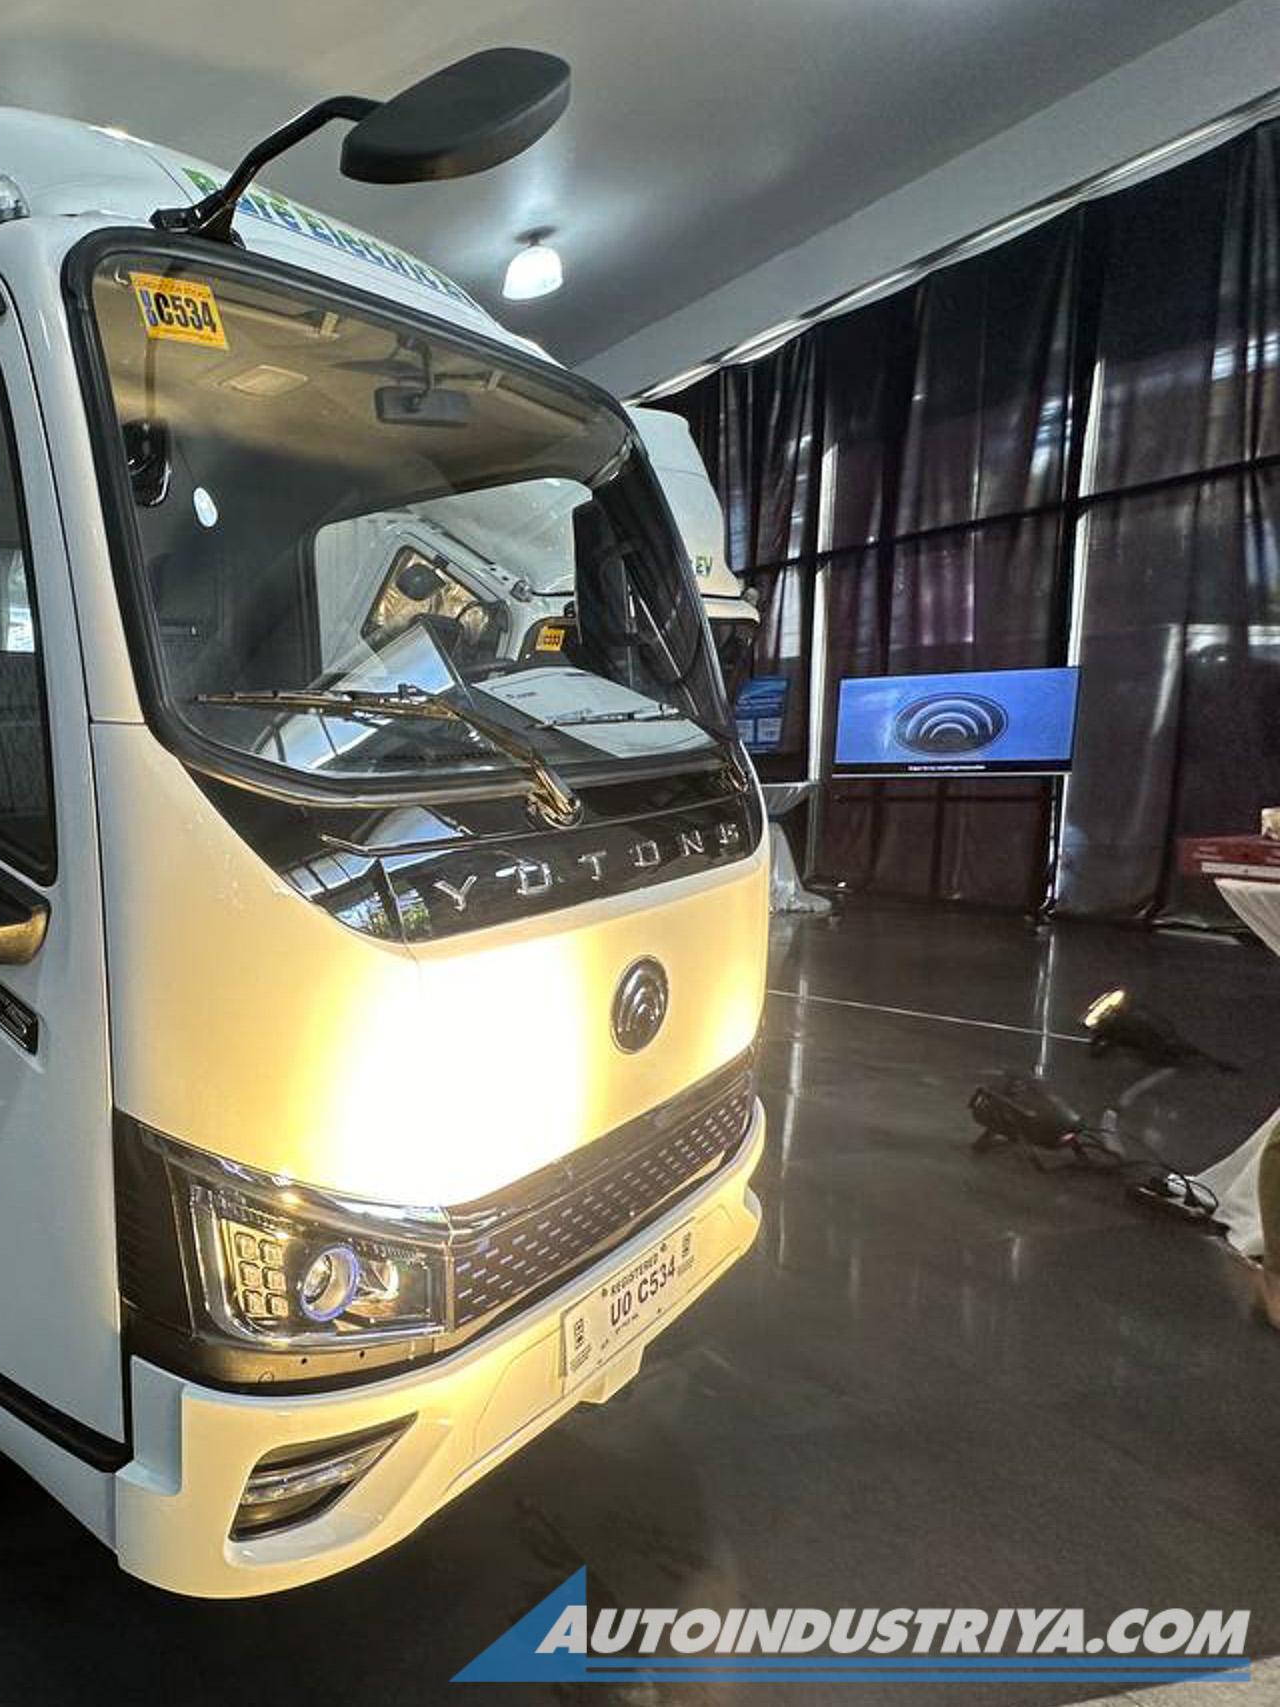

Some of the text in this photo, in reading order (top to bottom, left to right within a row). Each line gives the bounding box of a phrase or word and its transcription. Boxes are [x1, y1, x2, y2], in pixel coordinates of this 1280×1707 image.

[154, 291, 217, 333] C534
[611, 1252, 659, 1297] REGISTERED
[637, 1254, 676, 1303] C534
